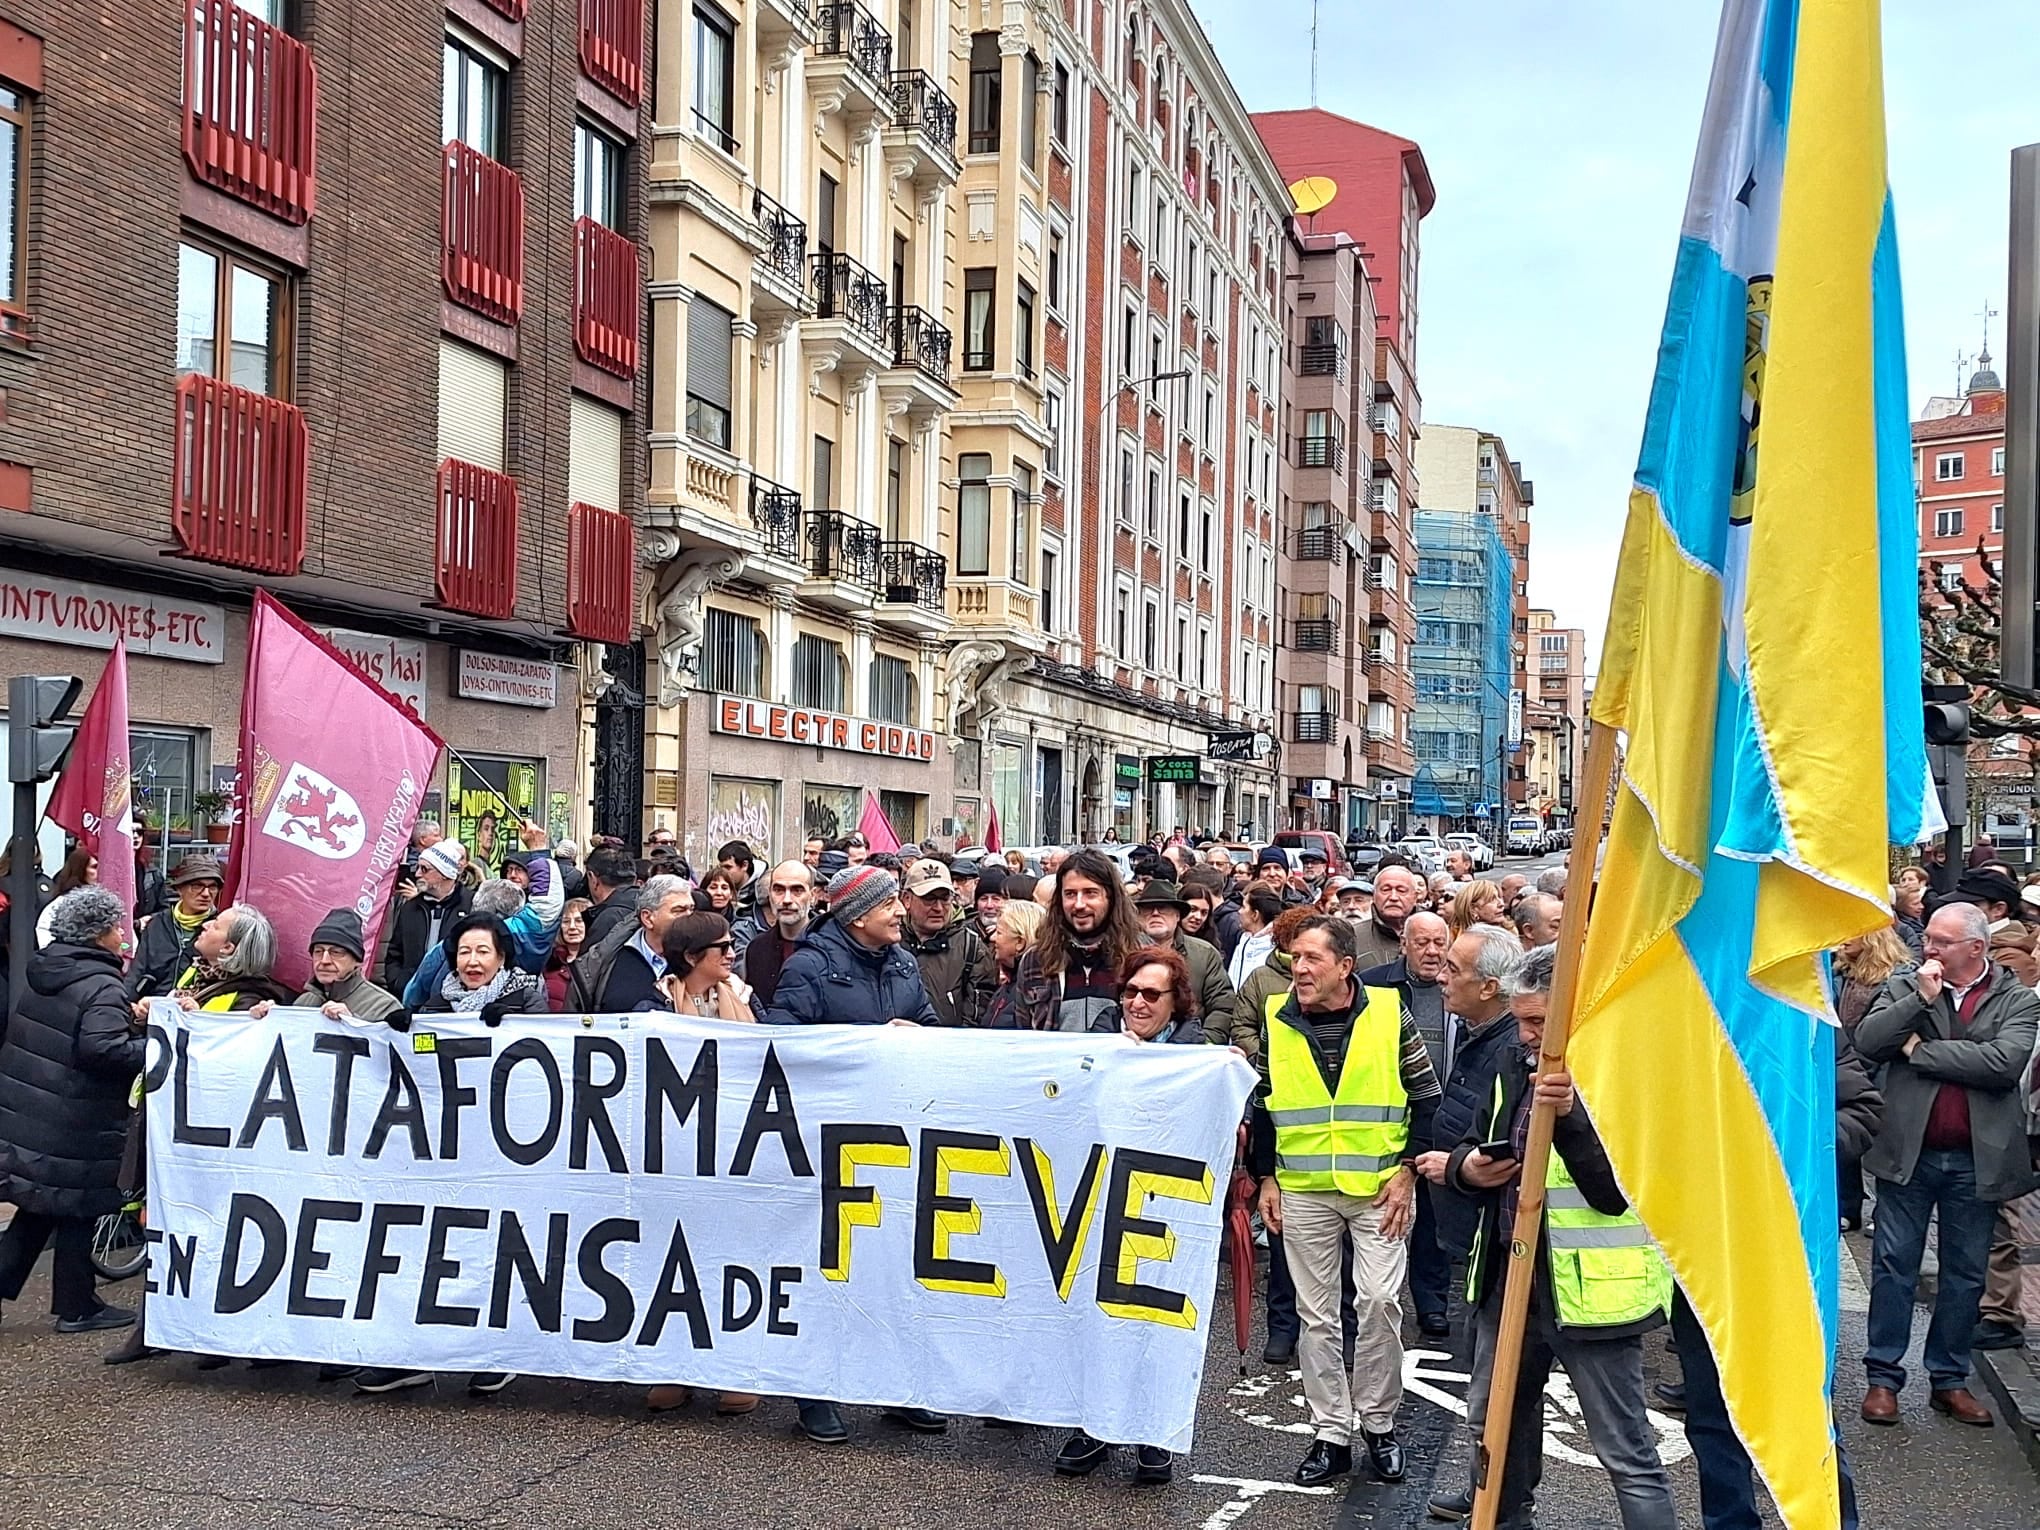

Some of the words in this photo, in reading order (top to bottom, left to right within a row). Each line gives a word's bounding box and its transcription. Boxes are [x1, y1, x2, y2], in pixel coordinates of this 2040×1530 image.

[0, 583, 212, 649] INTURONES-ETC.
[1153, 769, 1195, 779] sana
[1168, 761, 1194, 769] cosa
[145, 1022, 815, 1177] PLATAFORMA
[145, 1228, 198, 1299] EN
[214, 1192, 713, 1350] DEFENSA
[721, 1264, 803, 1337] DE
[820, 1122, 1216, 1331] FEVE
